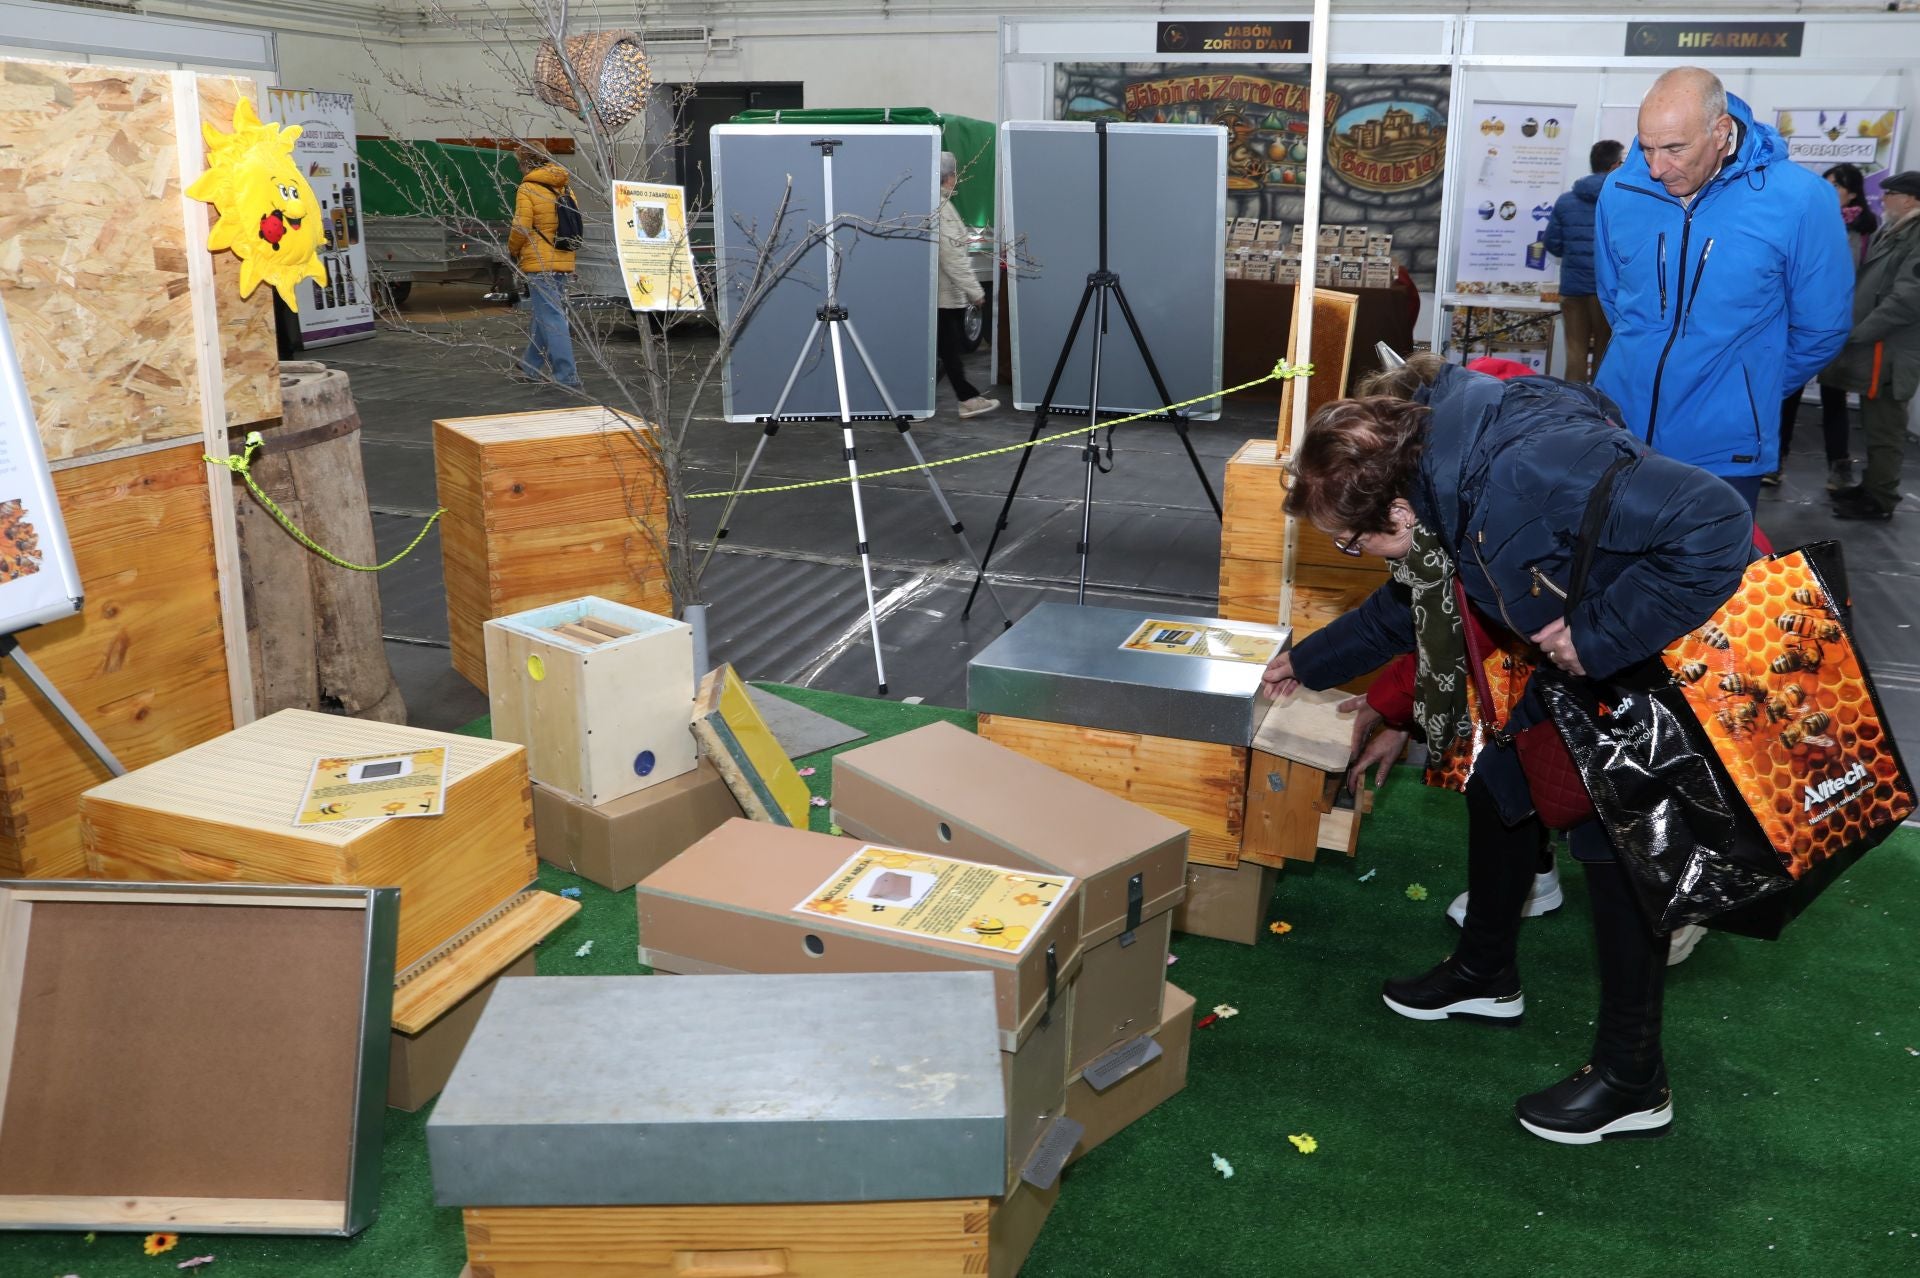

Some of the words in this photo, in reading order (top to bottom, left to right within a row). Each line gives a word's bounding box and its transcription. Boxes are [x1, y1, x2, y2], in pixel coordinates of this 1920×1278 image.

[1224, 24, 1272, 37] JABÓN
[1204, 39, 1251, 50] ZORRO
[1256, 39, 1292, 50] D'AVI
[1678, 32, 1788, 48] HIFARMAX
[1126, 80, 1183, 110] Jabón
[1188, 78, 1210, 100] de
[1211, 76, 1271, 104] Zorro
[1273, 84, 1339, 122] d'Ai
[1340, 151, 1434, 182] Sanabria
[1598, 698, 1633, 719] Aech
[1638, 719, 1646, 729] y
[1804, 762, 1868, 812] Alltech
[1839, 793, 1856, 806] salud
